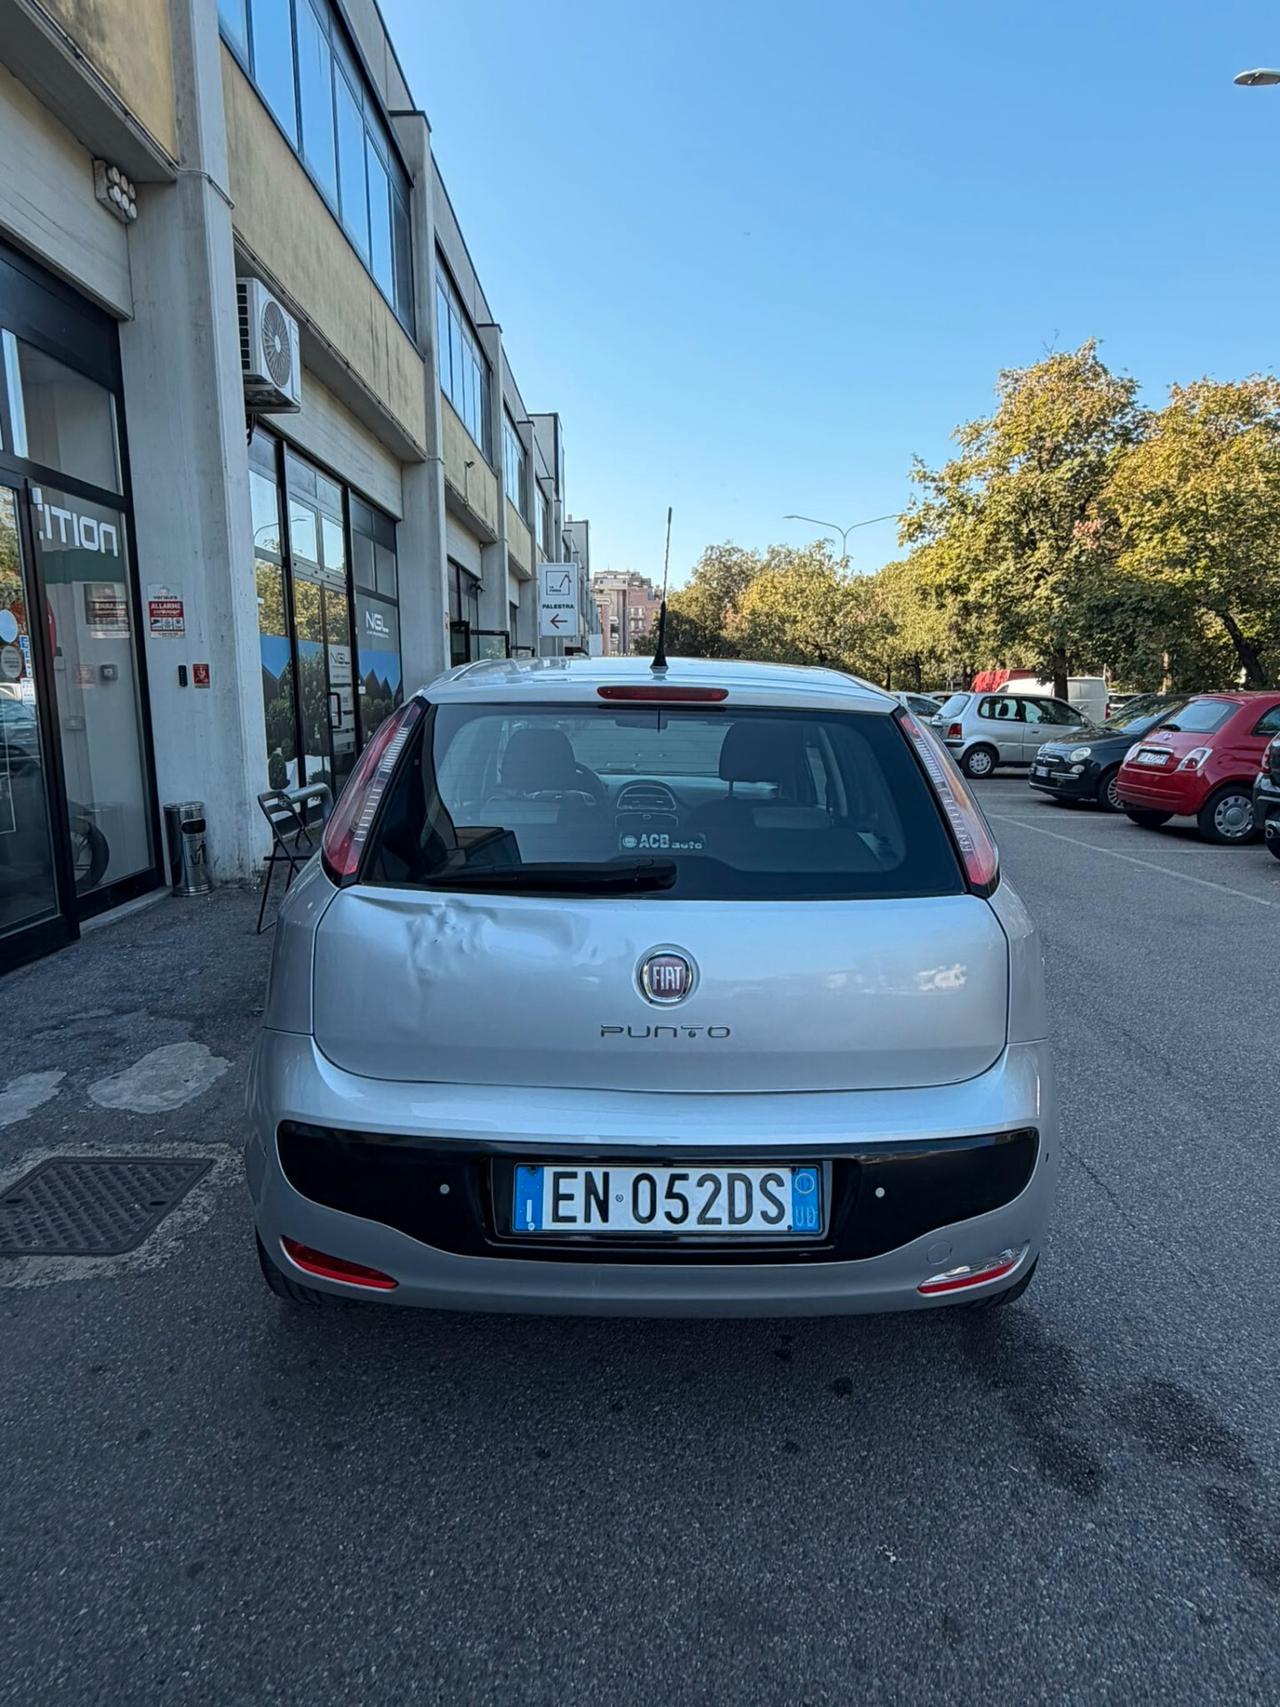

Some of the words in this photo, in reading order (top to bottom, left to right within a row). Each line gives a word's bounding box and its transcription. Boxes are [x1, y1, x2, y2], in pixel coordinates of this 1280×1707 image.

[639, 833, 670, 848] ACB
[653, 966, 682, 990] FIAT
[601, 1024, 731, 1039] PUNTO
[552, 1171, 610, 1224] EN
[632, 1172, 786, 1226] 052DS
